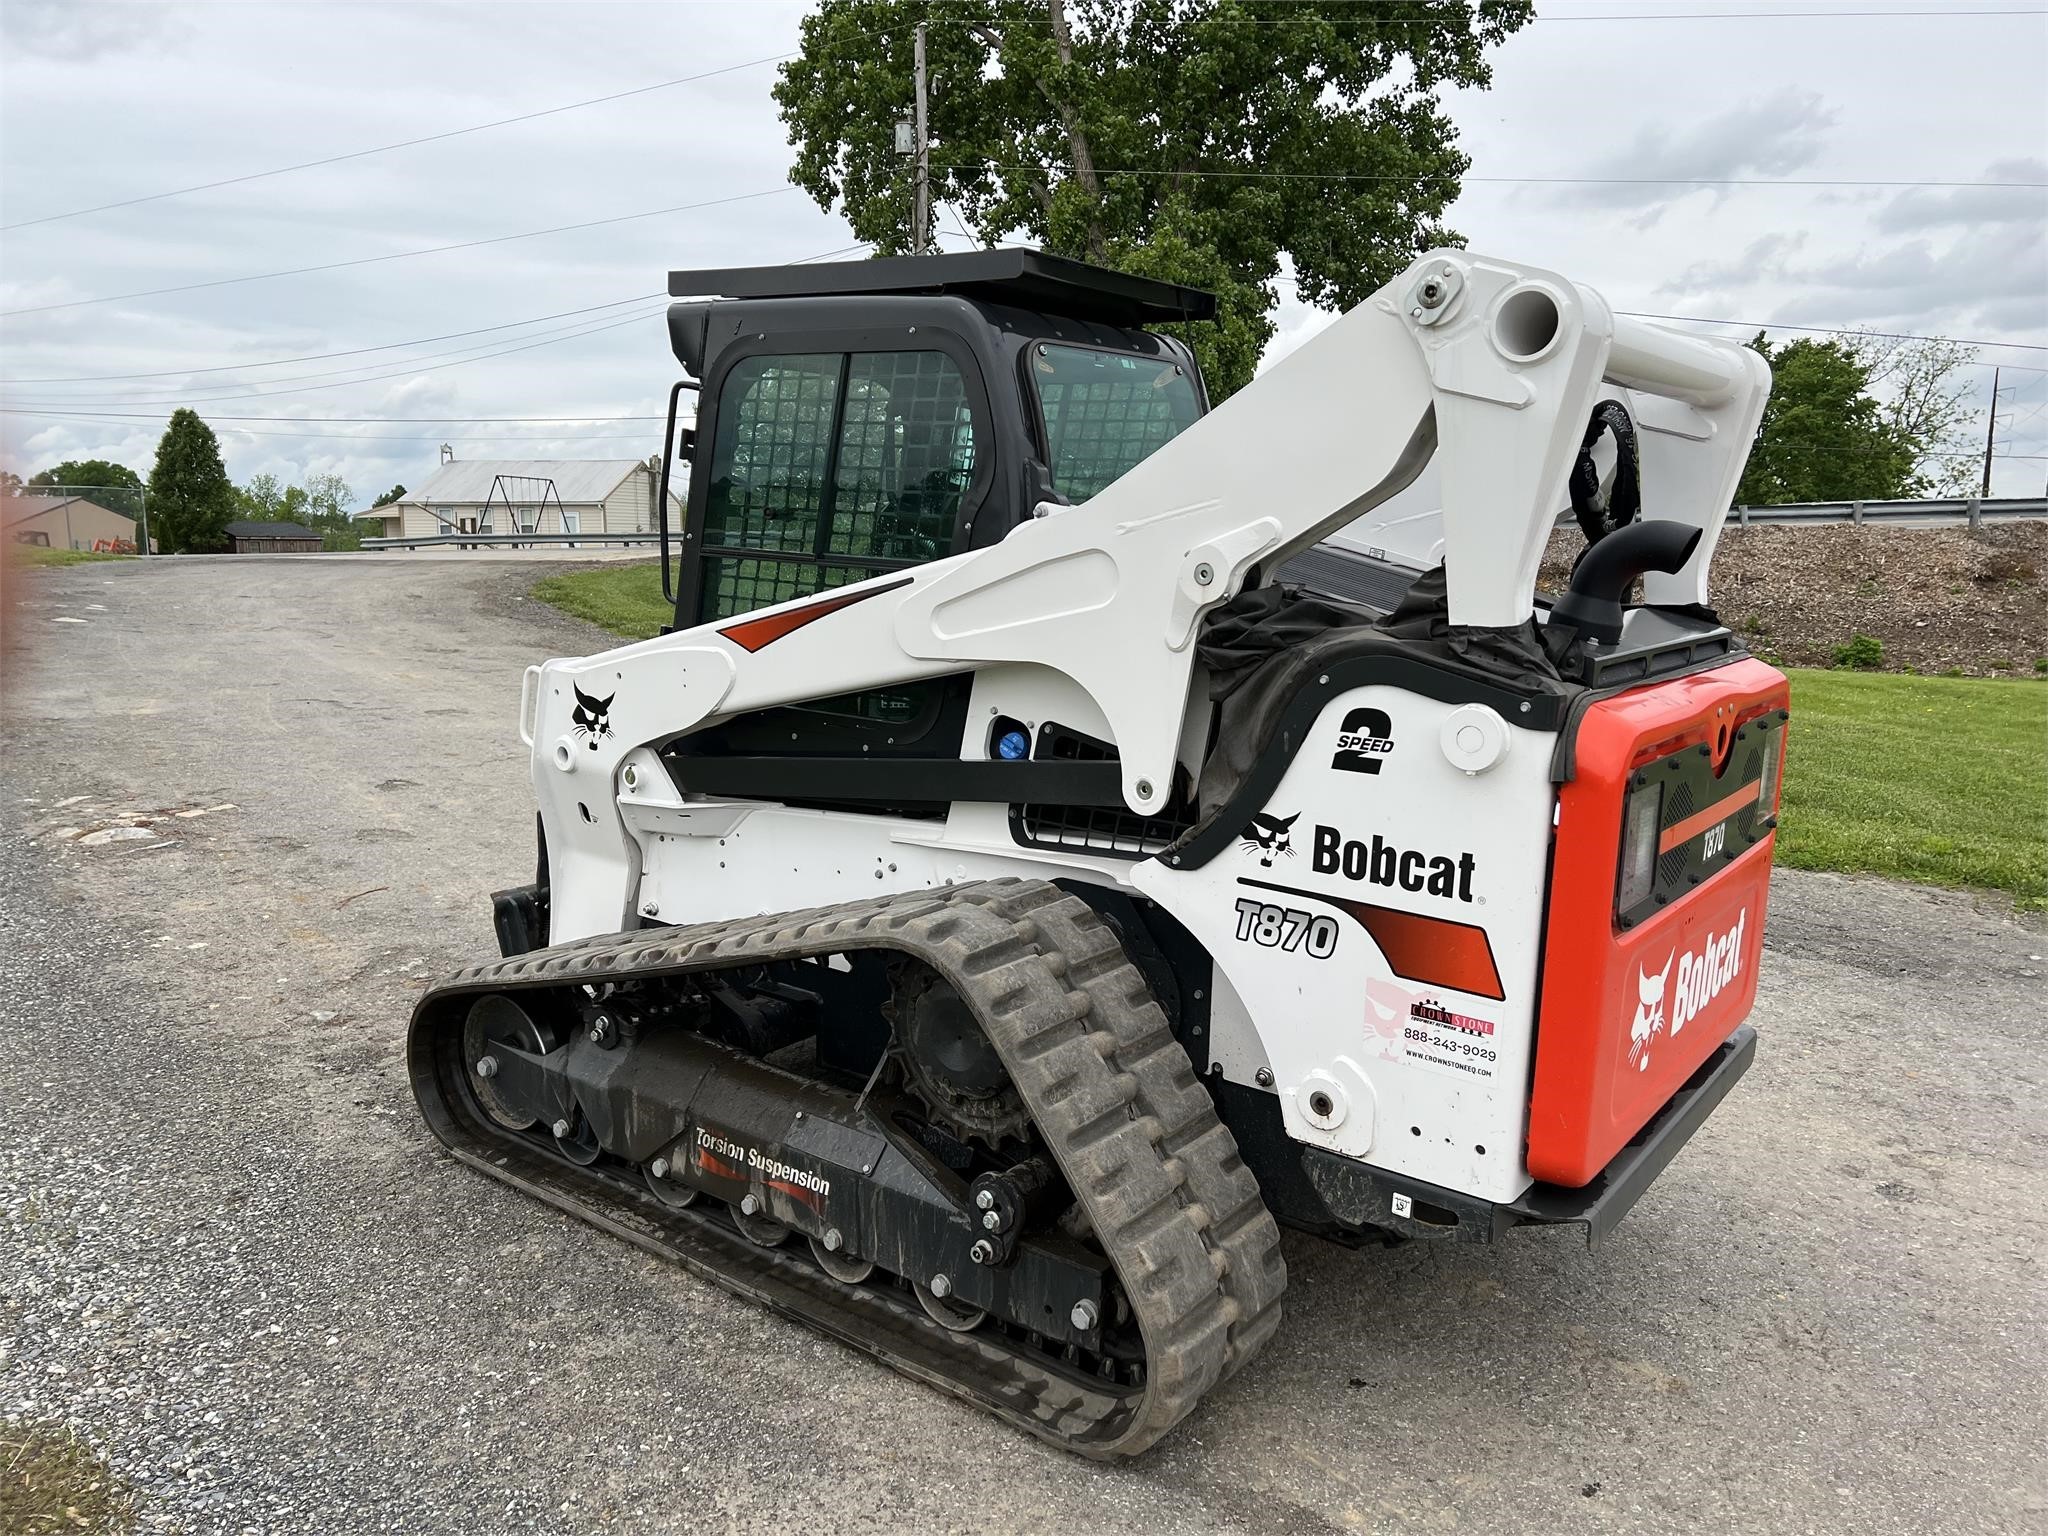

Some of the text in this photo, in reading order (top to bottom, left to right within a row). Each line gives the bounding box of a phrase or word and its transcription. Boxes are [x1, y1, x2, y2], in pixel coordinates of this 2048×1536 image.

[1331, 708, 1391, 775] 2
[1337, 735, 1394, 753] SPEED
[1312, 824, 1475, 902] Bobcat
[1702, 823, 1725, 862] T870
[1235, 897, 1340, 960] T870
[1670, 907, 1745, 1037] Bobcat
[1404, 1028, 1496, 1061] 888-243-9029
[1411, 1016, 1457, 1031] EQUIPMENT NETWORK
[1406, 1049, 1492, 1077] WWW.CROWNSTONEEQ.COM
[697, 1127, 830, 1195] Torsion Suspension
